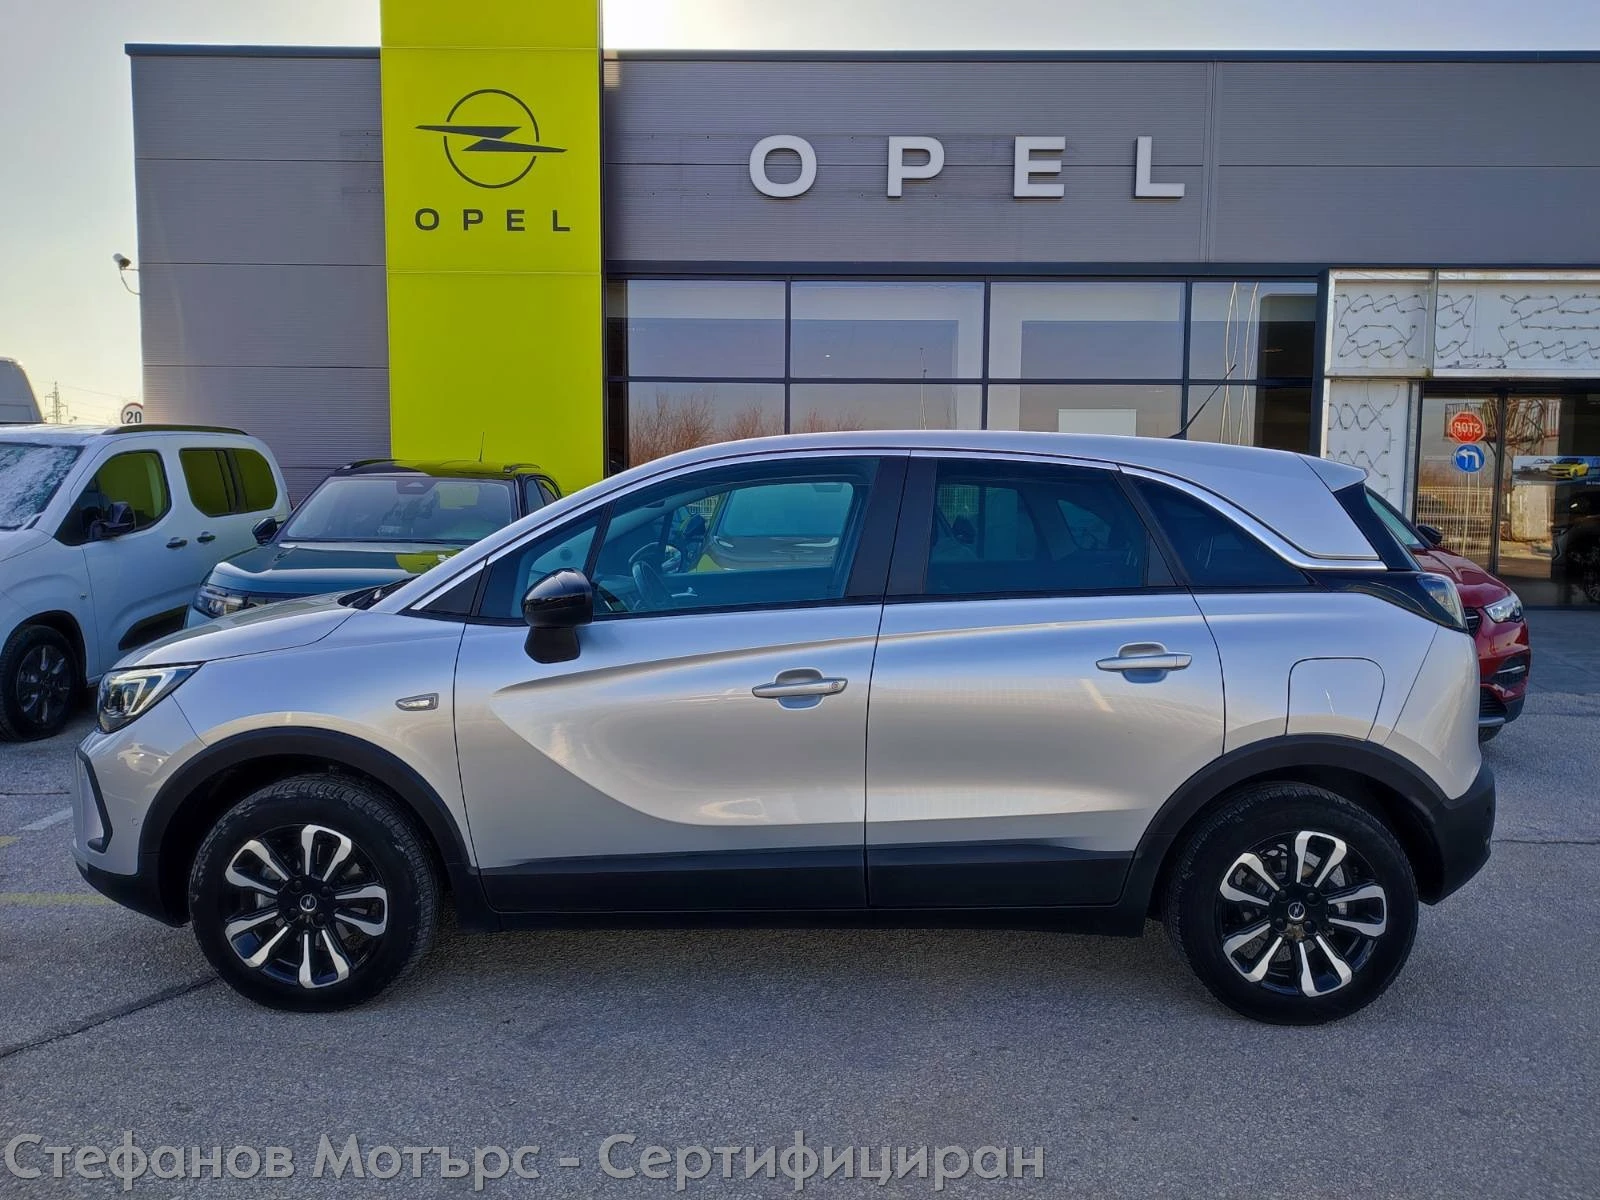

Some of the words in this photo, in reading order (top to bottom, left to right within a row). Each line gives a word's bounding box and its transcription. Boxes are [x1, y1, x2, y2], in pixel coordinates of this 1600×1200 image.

[749, 134, 1186, 199] OPEL
[415, 208, 571, 232] OPEL
[126, 411, 142, 424] 20
